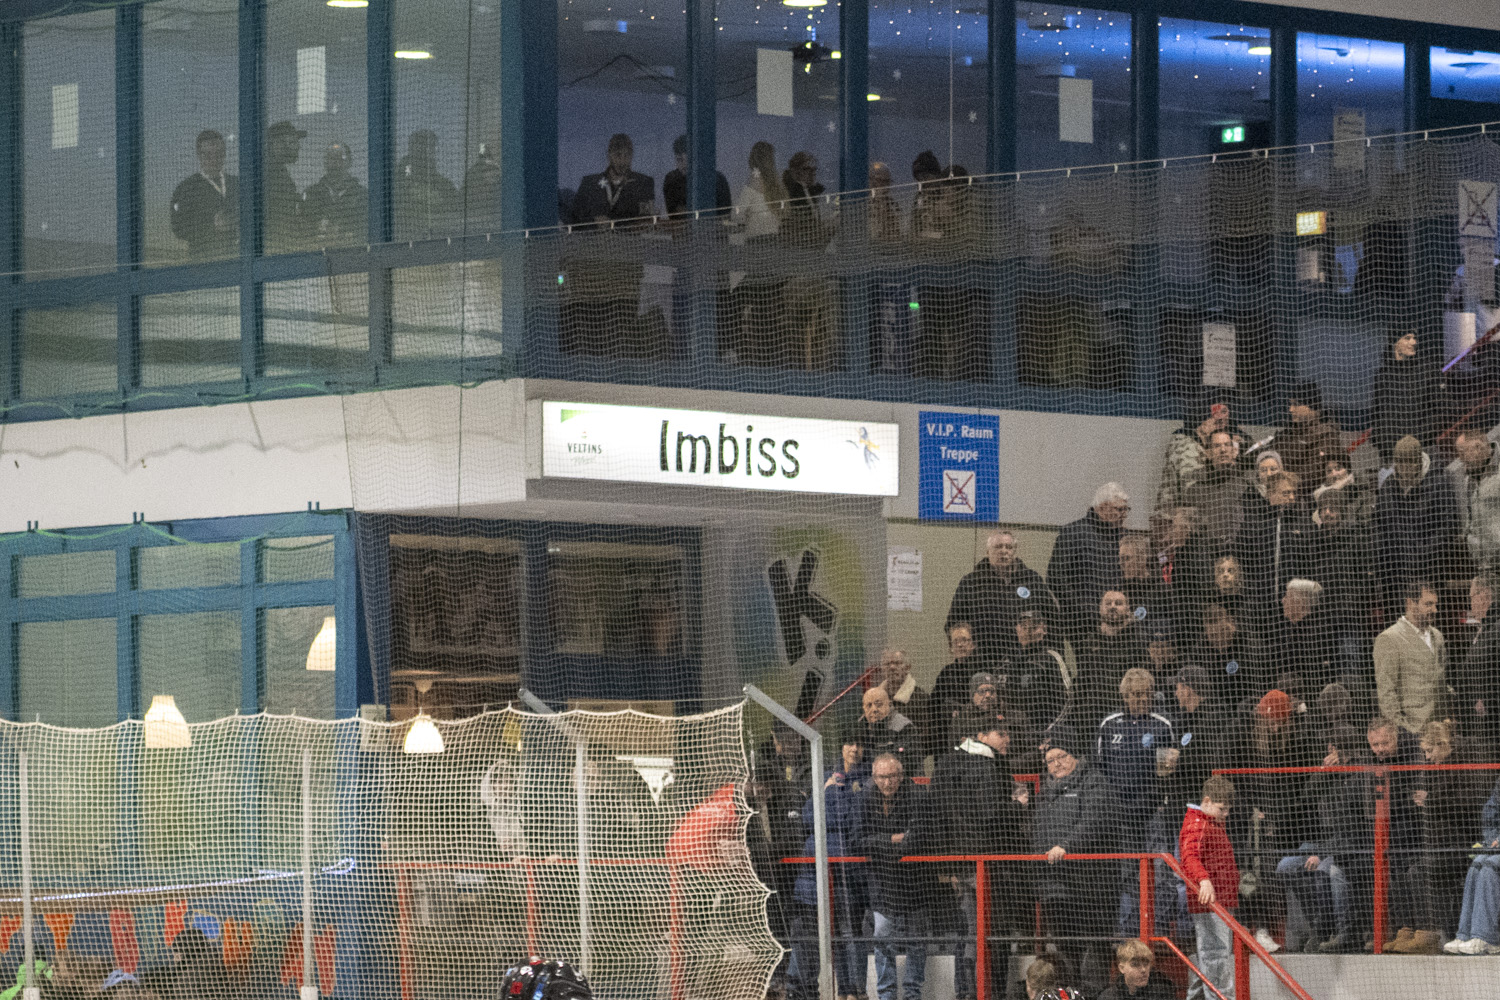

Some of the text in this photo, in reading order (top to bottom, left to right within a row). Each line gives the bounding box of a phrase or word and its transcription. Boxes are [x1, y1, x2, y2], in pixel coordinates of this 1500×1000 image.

[926, 423, 994, 439] V.I.P. Raum
[567, 442, 603, 454] VELTINS
[660, 420, 800, 478] Imbiss
[940, 446, 979, 462] Treppe
